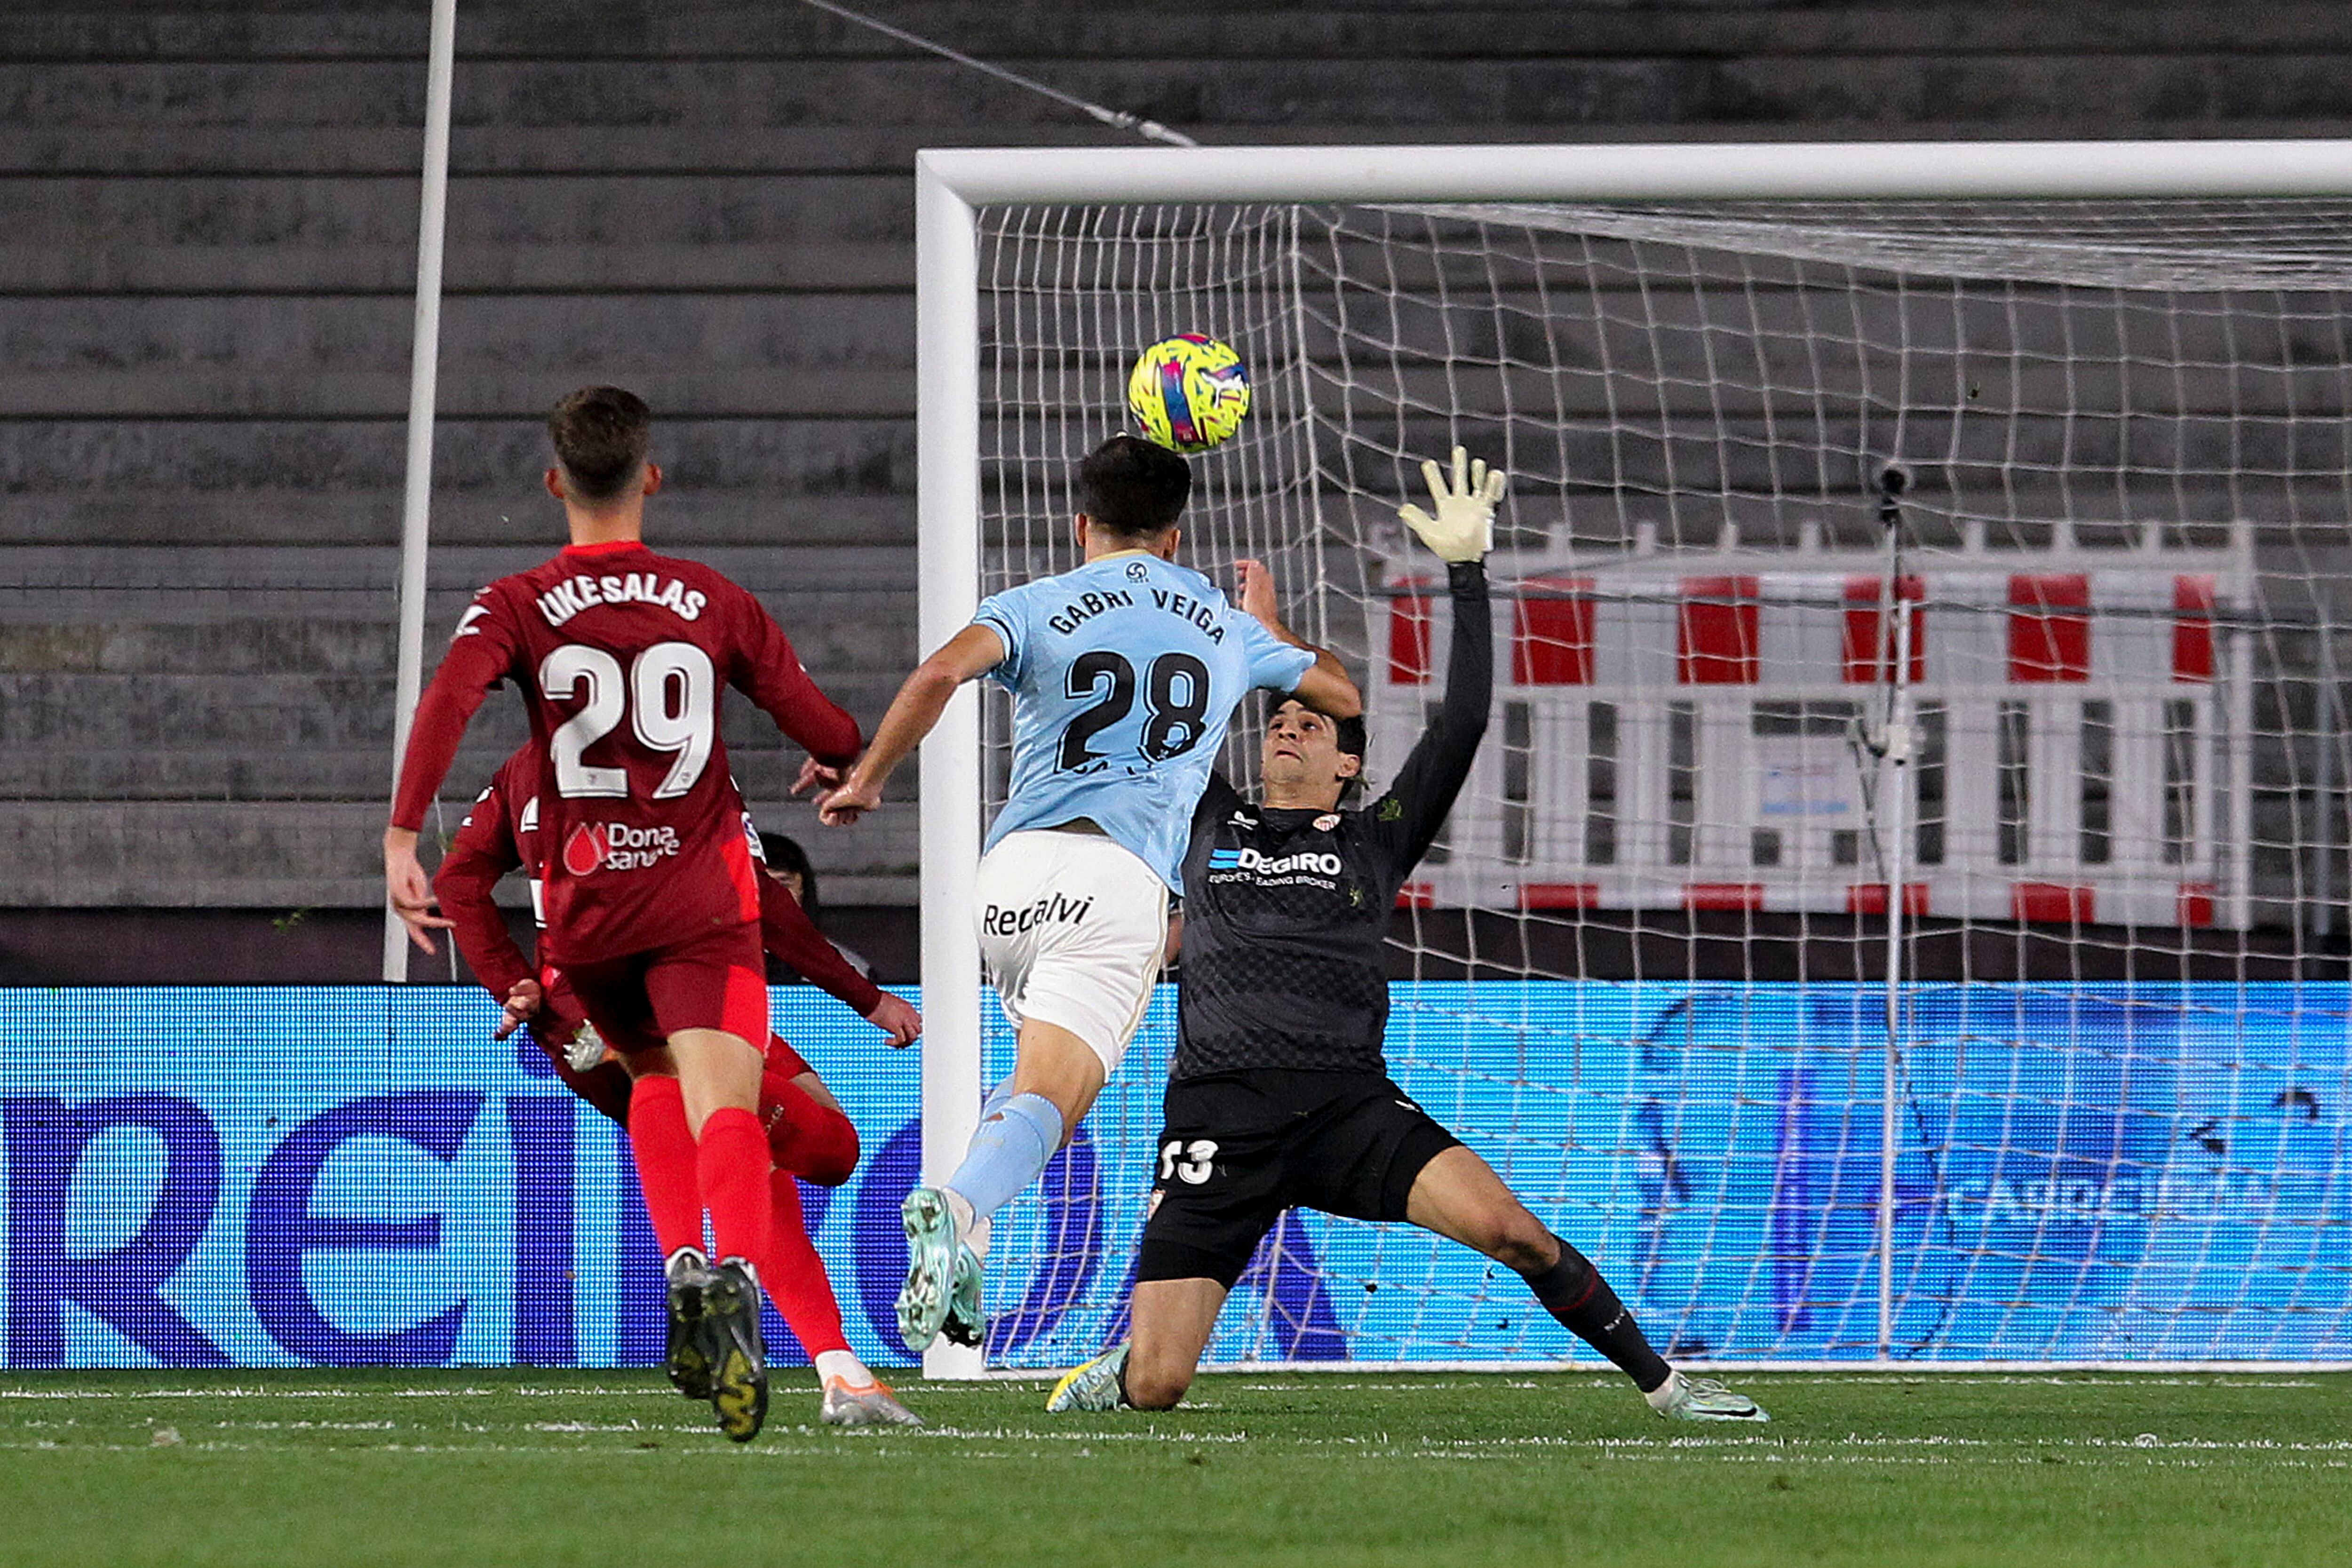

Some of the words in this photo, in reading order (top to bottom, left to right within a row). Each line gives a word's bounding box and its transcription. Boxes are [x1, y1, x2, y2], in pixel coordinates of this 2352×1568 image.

[1049, 590, 1134, 635] GABRI
[1151, 588, 1224, 645] VEIGA
[539, 641, 715, 799] 29
[1053, 651, 1210, 774] 28
[608, 823, 675, 848] Dona
[1238, 847, 1342, 876] DEGIRO
[983, 891, 1094, 936] Recalvi
[1160, 1139, 1219, 1185] 13
